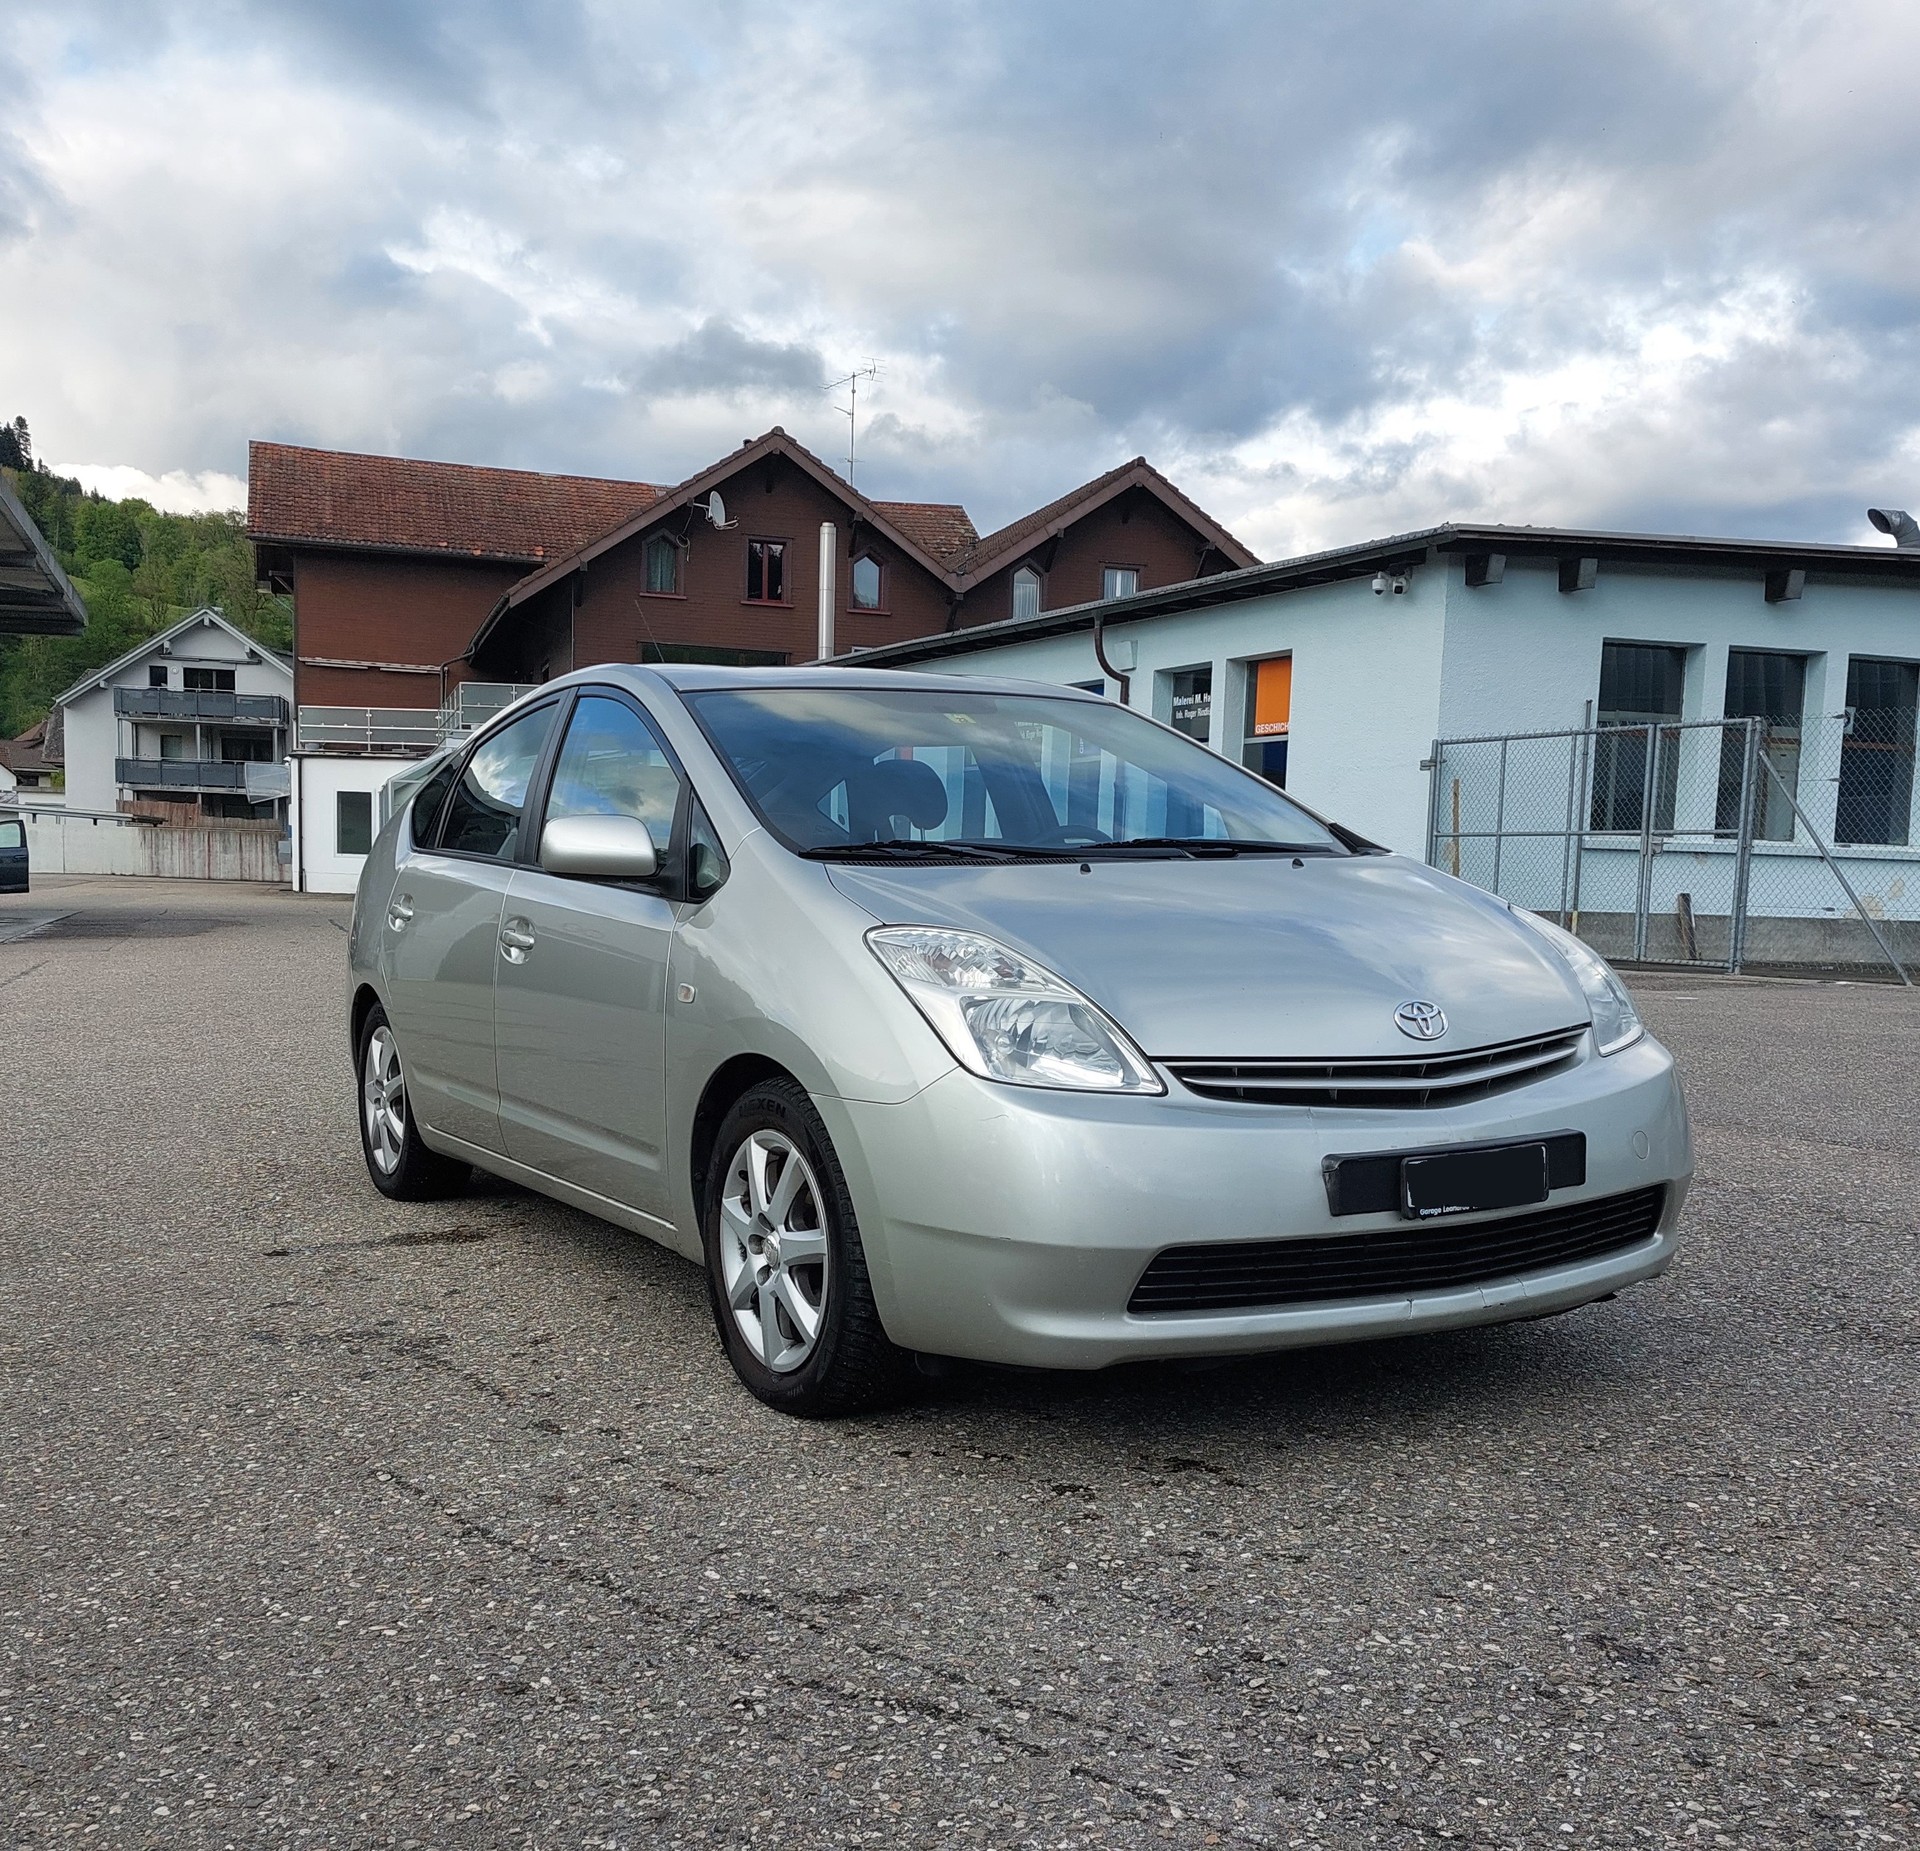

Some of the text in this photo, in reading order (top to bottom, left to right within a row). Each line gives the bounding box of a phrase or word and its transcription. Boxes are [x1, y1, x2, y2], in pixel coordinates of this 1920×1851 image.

[1173, 694, 1195, 706] Malerei
[1195, 693, 1202, 704] M.
[1419, 1207, 1441, 1216] Garage
